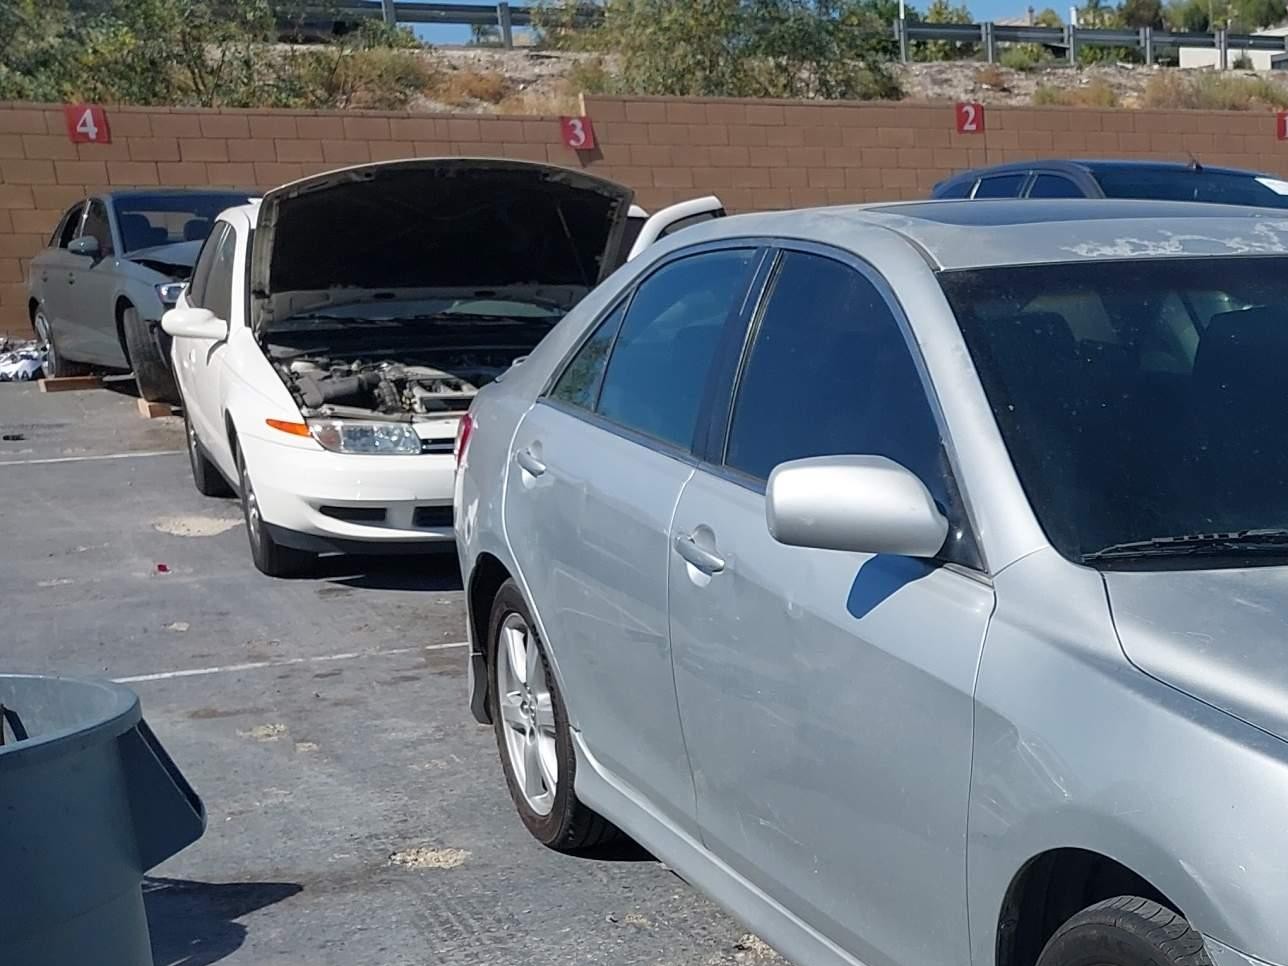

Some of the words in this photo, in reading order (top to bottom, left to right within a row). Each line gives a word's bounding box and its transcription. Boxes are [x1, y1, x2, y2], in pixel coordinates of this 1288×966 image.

[76, 108, 98, 138] 4
[961, 105, 977, 131] 2
[569, 119, 586, 146] 3
